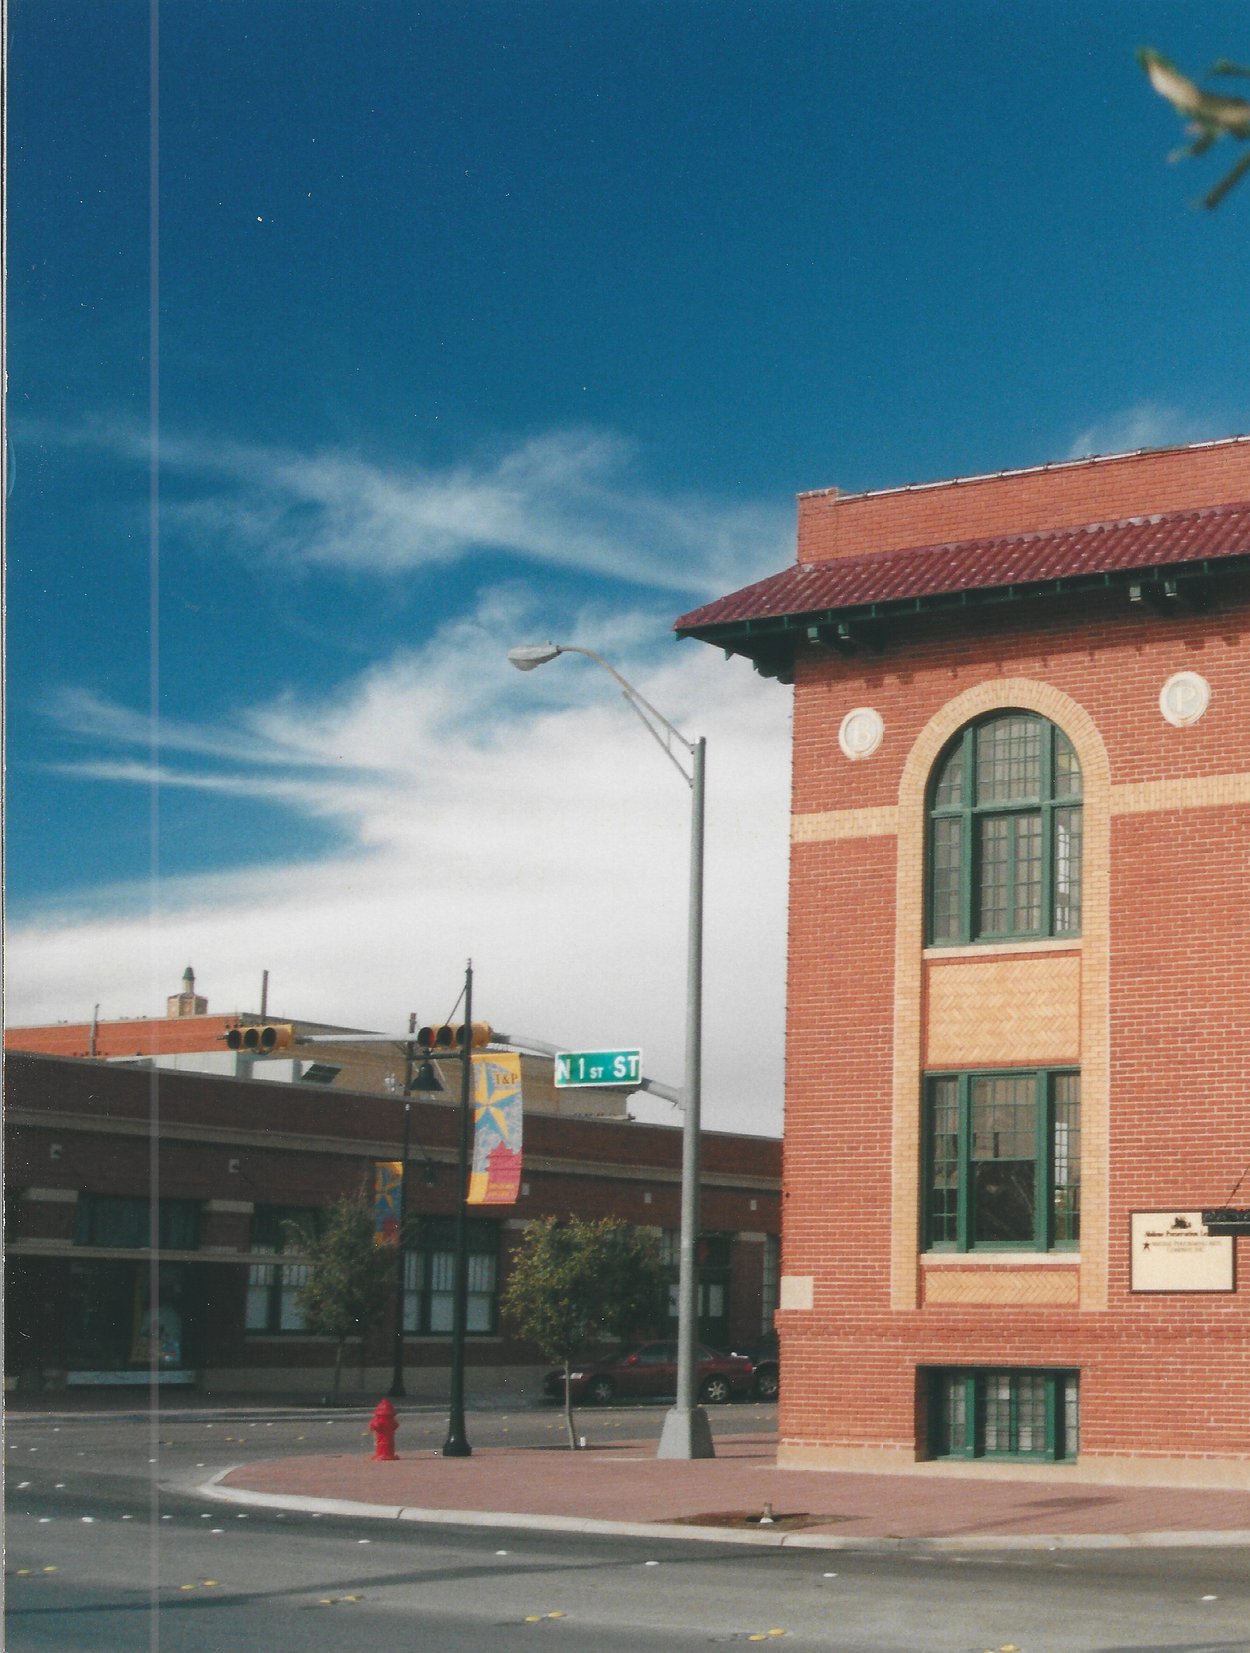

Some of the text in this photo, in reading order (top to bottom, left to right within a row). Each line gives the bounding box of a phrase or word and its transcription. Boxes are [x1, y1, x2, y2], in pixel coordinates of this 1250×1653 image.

[1175, 685, 1197, 712] P
[558, 1059, 571, 1080] N
[613, 1055, 640, 1078] ST
